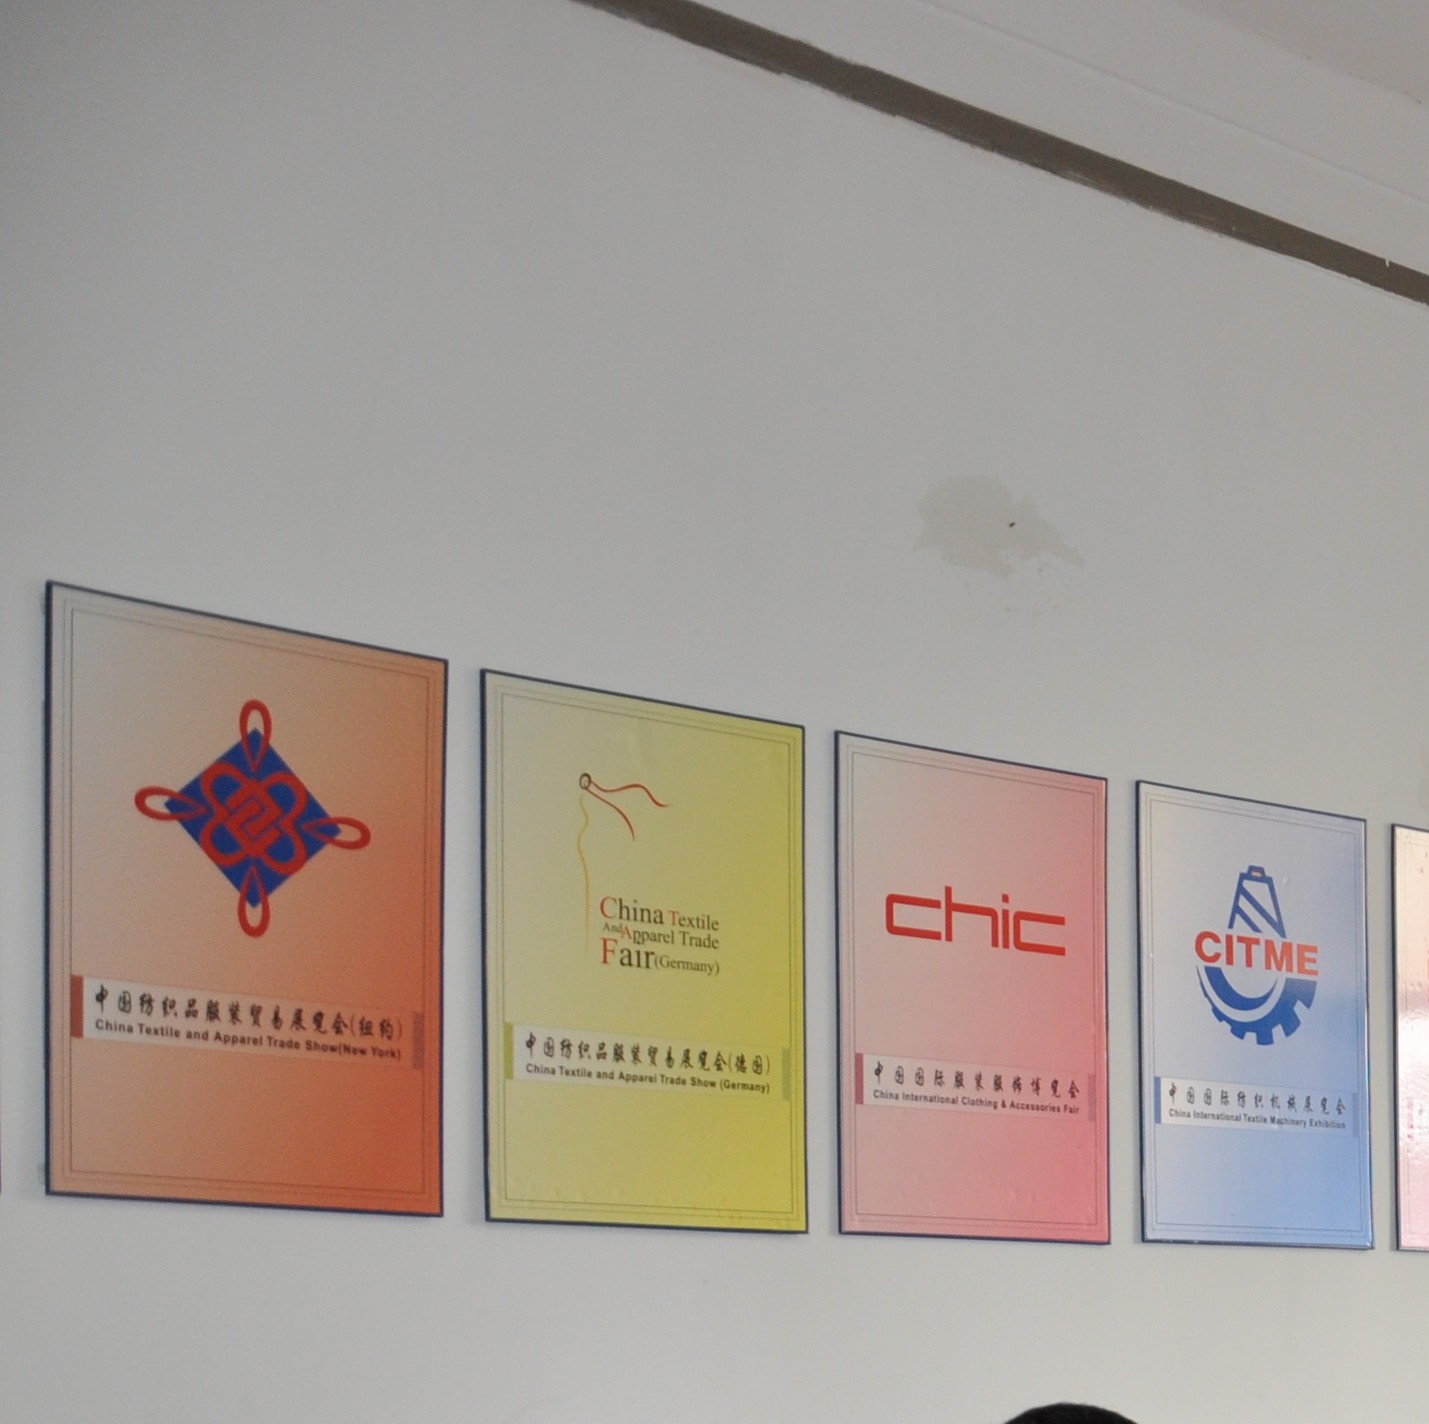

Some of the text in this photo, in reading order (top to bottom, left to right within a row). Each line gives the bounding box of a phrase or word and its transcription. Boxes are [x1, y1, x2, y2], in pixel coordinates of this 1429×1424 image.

[600, 896, 720, 931] China Textile
[885, 885, 1066, 957] chic
[601, 937, 655, 969] Fair
[679, 931, 720, 949] Trade
[1194, 931, 1319, 977] CITME
[95, 1018, 134, 1034] China
[138, 1022, 181, 1038] Textile
[186, 1029, 209, 1042] and
[214, 1031, 264, 1048] Apparel
[268, 1035, 301, 1050] Trade
[526, 1063, 770, 1094] China Textile and Apparel Trade Show (Germany)
[873, 1089, 899, 1101] China
[902, 1092, 958, 1105] International
[961, 1096, 998, 1110] Clothing
[1010, 1100, 1061, 1113] Accessories
[1064, 1104, 1079, 1114] Fair
[1169, 1108, 1346, 1129] China International Textile Machinery Exhibition
